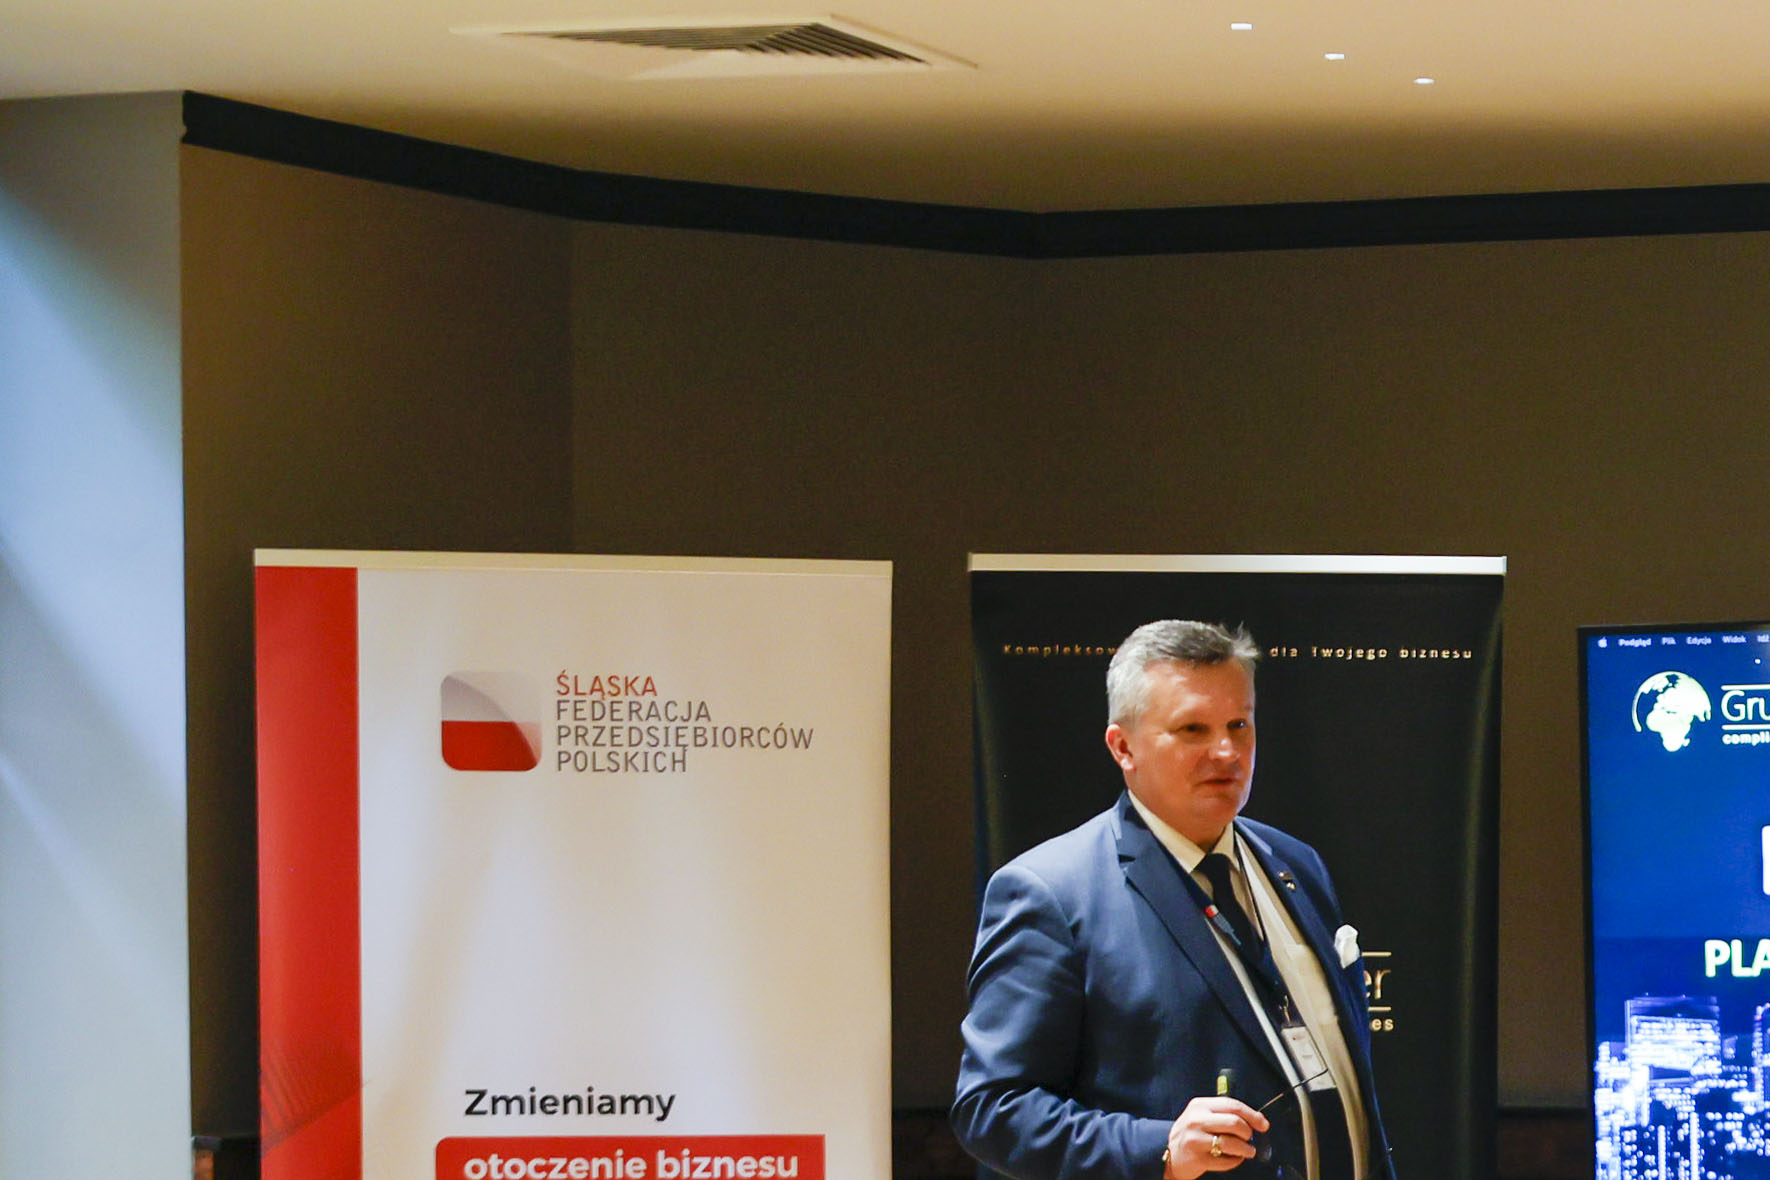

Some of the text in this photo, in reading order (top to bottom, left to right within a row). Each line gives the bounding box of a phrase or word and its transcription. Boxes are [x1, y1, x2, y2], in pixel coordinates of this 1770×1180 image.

[1003, 643, 1472, 660] Kompleksow dla Twojego biznesu
[556, 670, 658, 700] ŚLĄSKA
[556, 700, 712, 723] FEDERACJA
[556, 722, 815, 752] PRZEDSIĘBIORCÓW
[556, 749, 688, 773] POLSKICH
[464, 1086, 676, 1122] Zmieniamy
[463, 1148, 799, 1180] otoczenie biznesu
